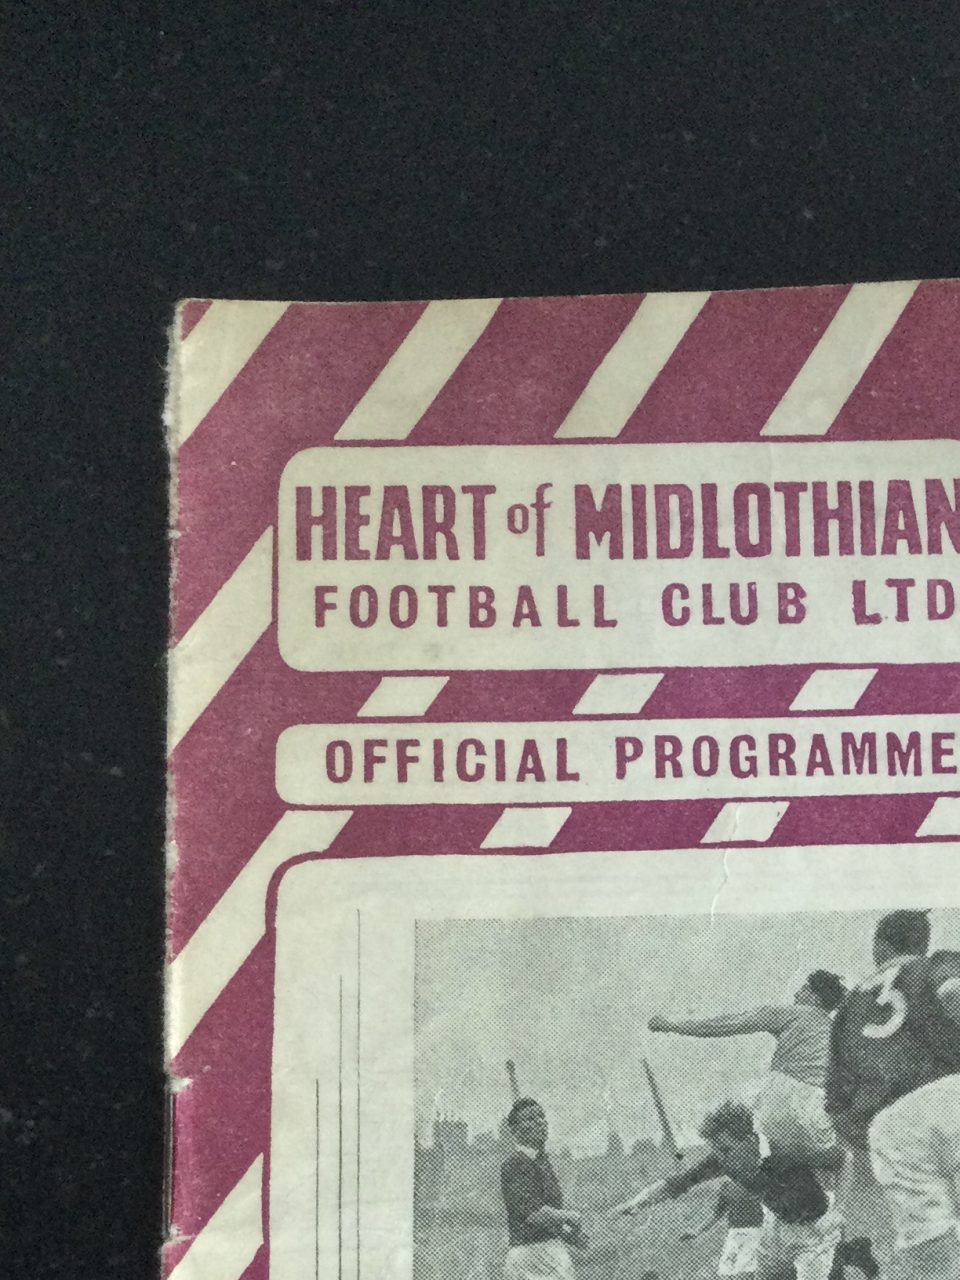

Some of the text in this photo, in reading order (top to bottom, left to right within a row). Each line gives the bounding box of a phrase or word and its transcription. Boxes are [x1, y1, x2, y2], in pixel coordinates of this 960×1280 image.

[295, 484, 497, 562] HEART
[506, 482, 554, 558] of
[313, 577, 956, 630] FOOTBALL CLUB LTD
[325, 730, 958, 784] OFFICIAL PROGRAMME
